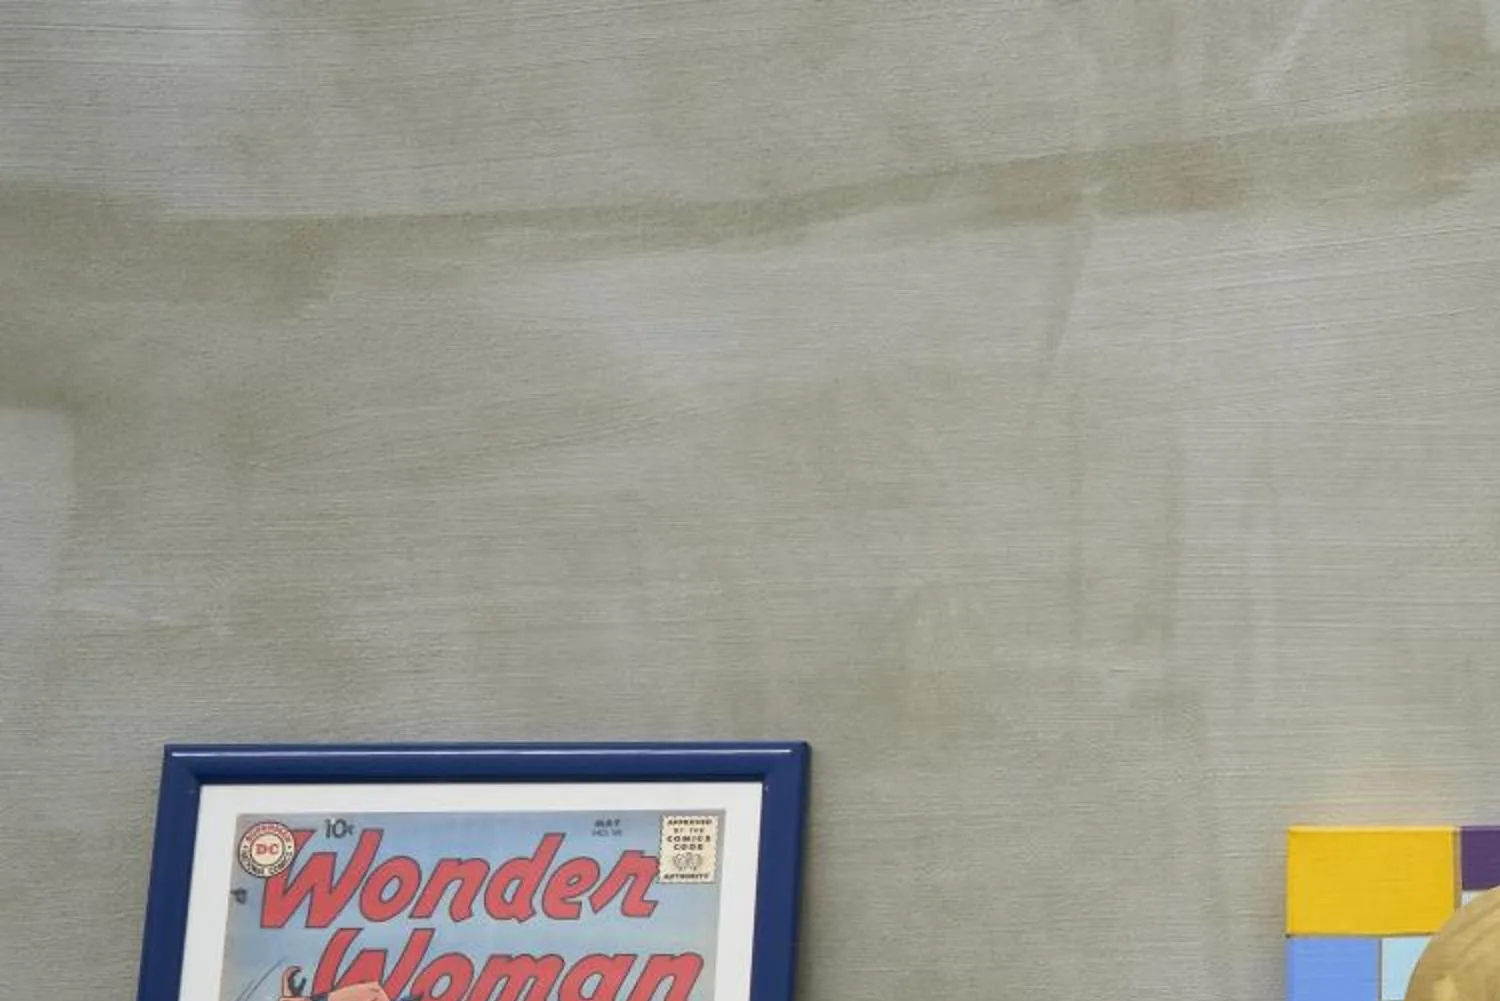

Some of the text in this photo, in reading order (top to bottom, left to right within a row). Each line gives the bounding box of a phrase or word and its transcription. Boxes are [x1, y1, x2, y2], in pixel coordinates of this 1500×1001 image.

[666, 835, 712, 843] COMICS
[673, 843, 704, 851] CODE
[260, 828, 661, 929] Wonder
